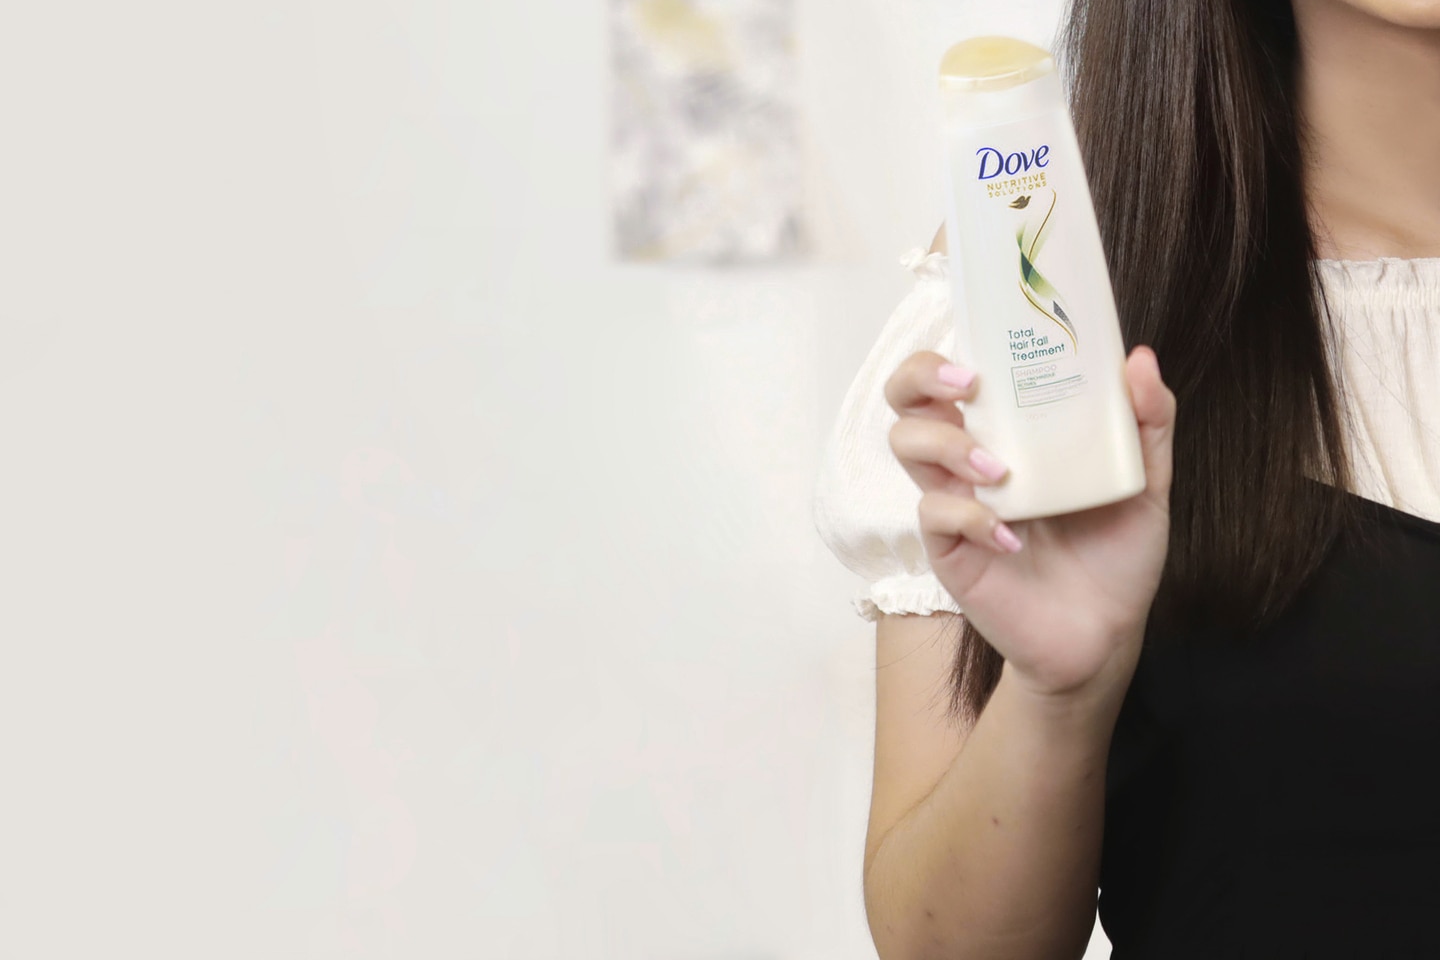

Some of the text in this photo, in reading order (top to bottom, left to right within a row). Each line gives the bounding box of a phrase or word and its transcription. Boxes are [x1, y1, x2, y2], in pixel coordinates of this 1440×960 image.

[976, 145, 1050, 180] Dove
[987, 172, 1047, 191] NUTRITIVE
[988, 180, 1047, 198] SOLUTIONS
[1008, 328, 1034, 339] Total
[1009, 336, 1049, 351] Hair Fall
[1011, 343, 1065, 361] Treatment
